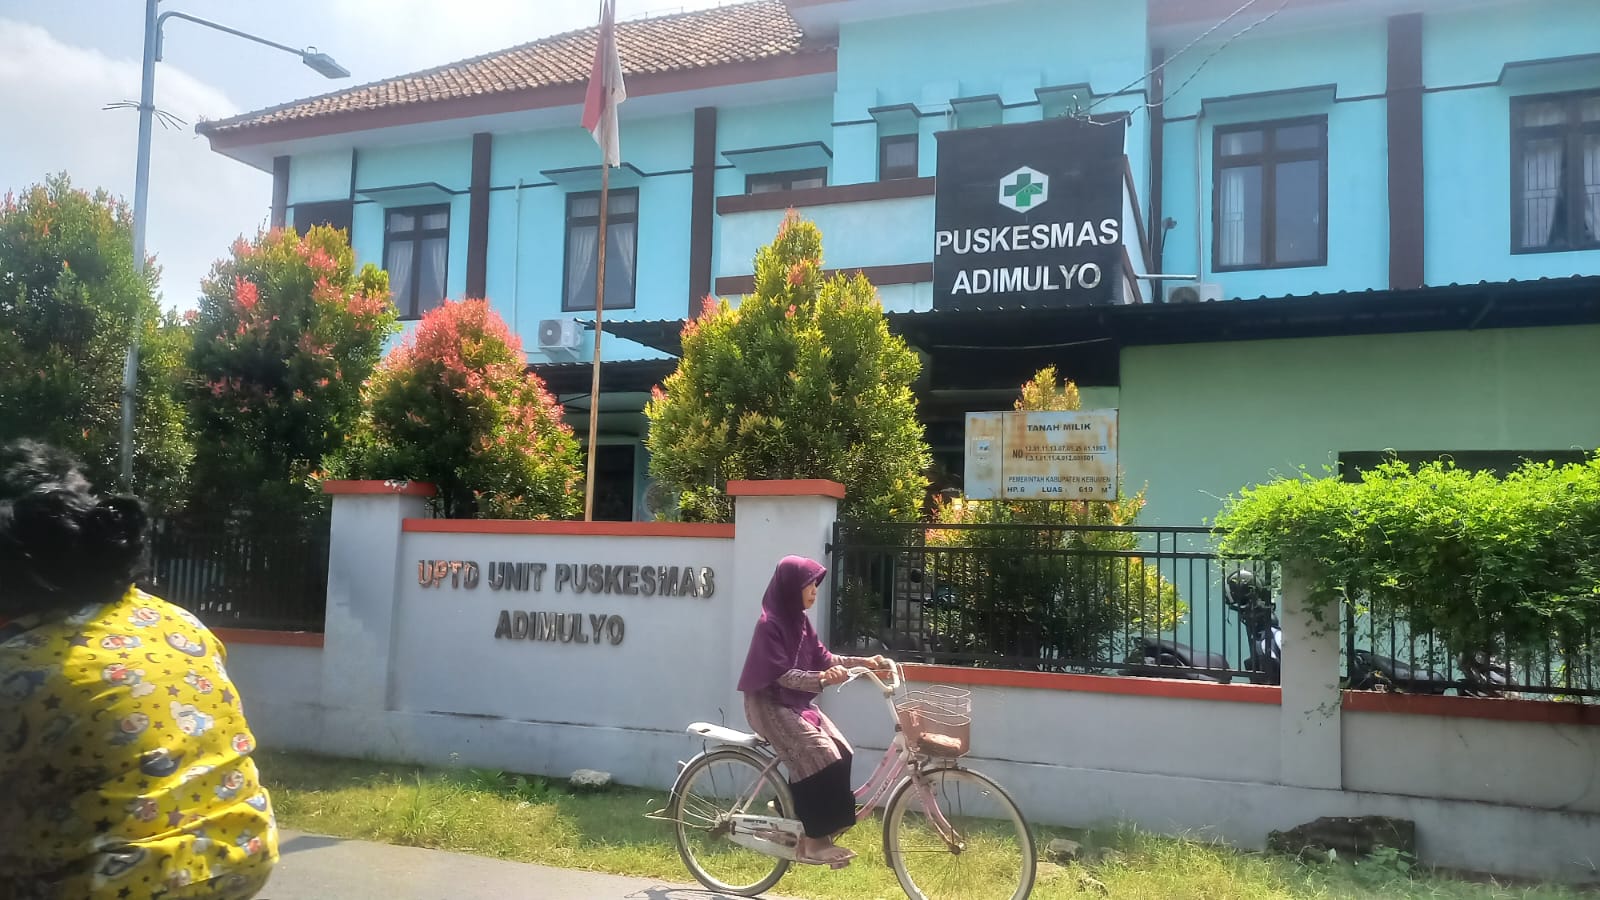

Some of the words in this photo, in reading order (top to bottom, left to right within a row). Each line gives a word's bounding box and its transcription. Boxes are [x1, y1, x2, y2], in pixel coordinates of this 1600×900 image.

[935, 218, 1119, 256] PUSKESMAS
[951, 262, 1102, 295] ADIMULYO
[1063, 423, 1092, 431] MILIK
[417, 559, 480, 590] UPTD
[488, 561, 547, 593] UNIT
[554, 563, 715, 599] PUSKESMAS
[494, 610, 625, 646] ADIMULYO
